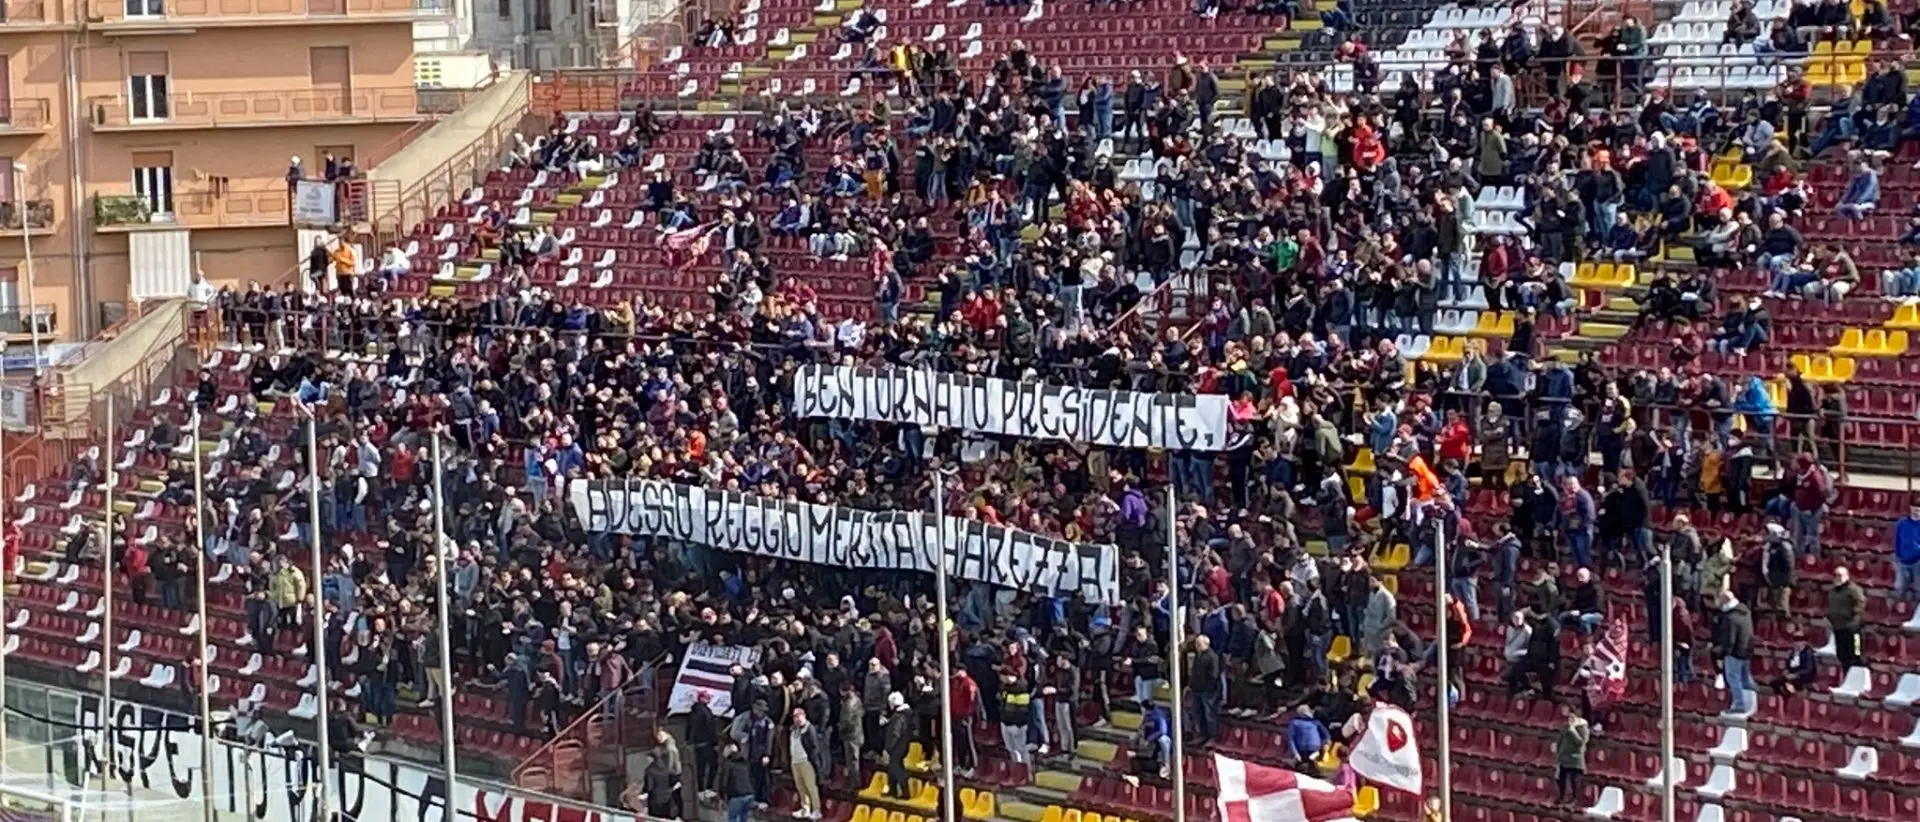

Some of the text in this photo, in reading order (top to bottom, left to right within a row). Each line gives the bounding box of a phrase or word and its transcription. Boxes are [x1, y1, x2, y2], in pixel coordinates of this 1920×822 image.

[803, 363, 988, 430] BENTORNATO
[587, 479, 693, 538] ADESSO
[705, 489, 801, 556] REGGIO
[809, 505, 916, 569] MERITA
